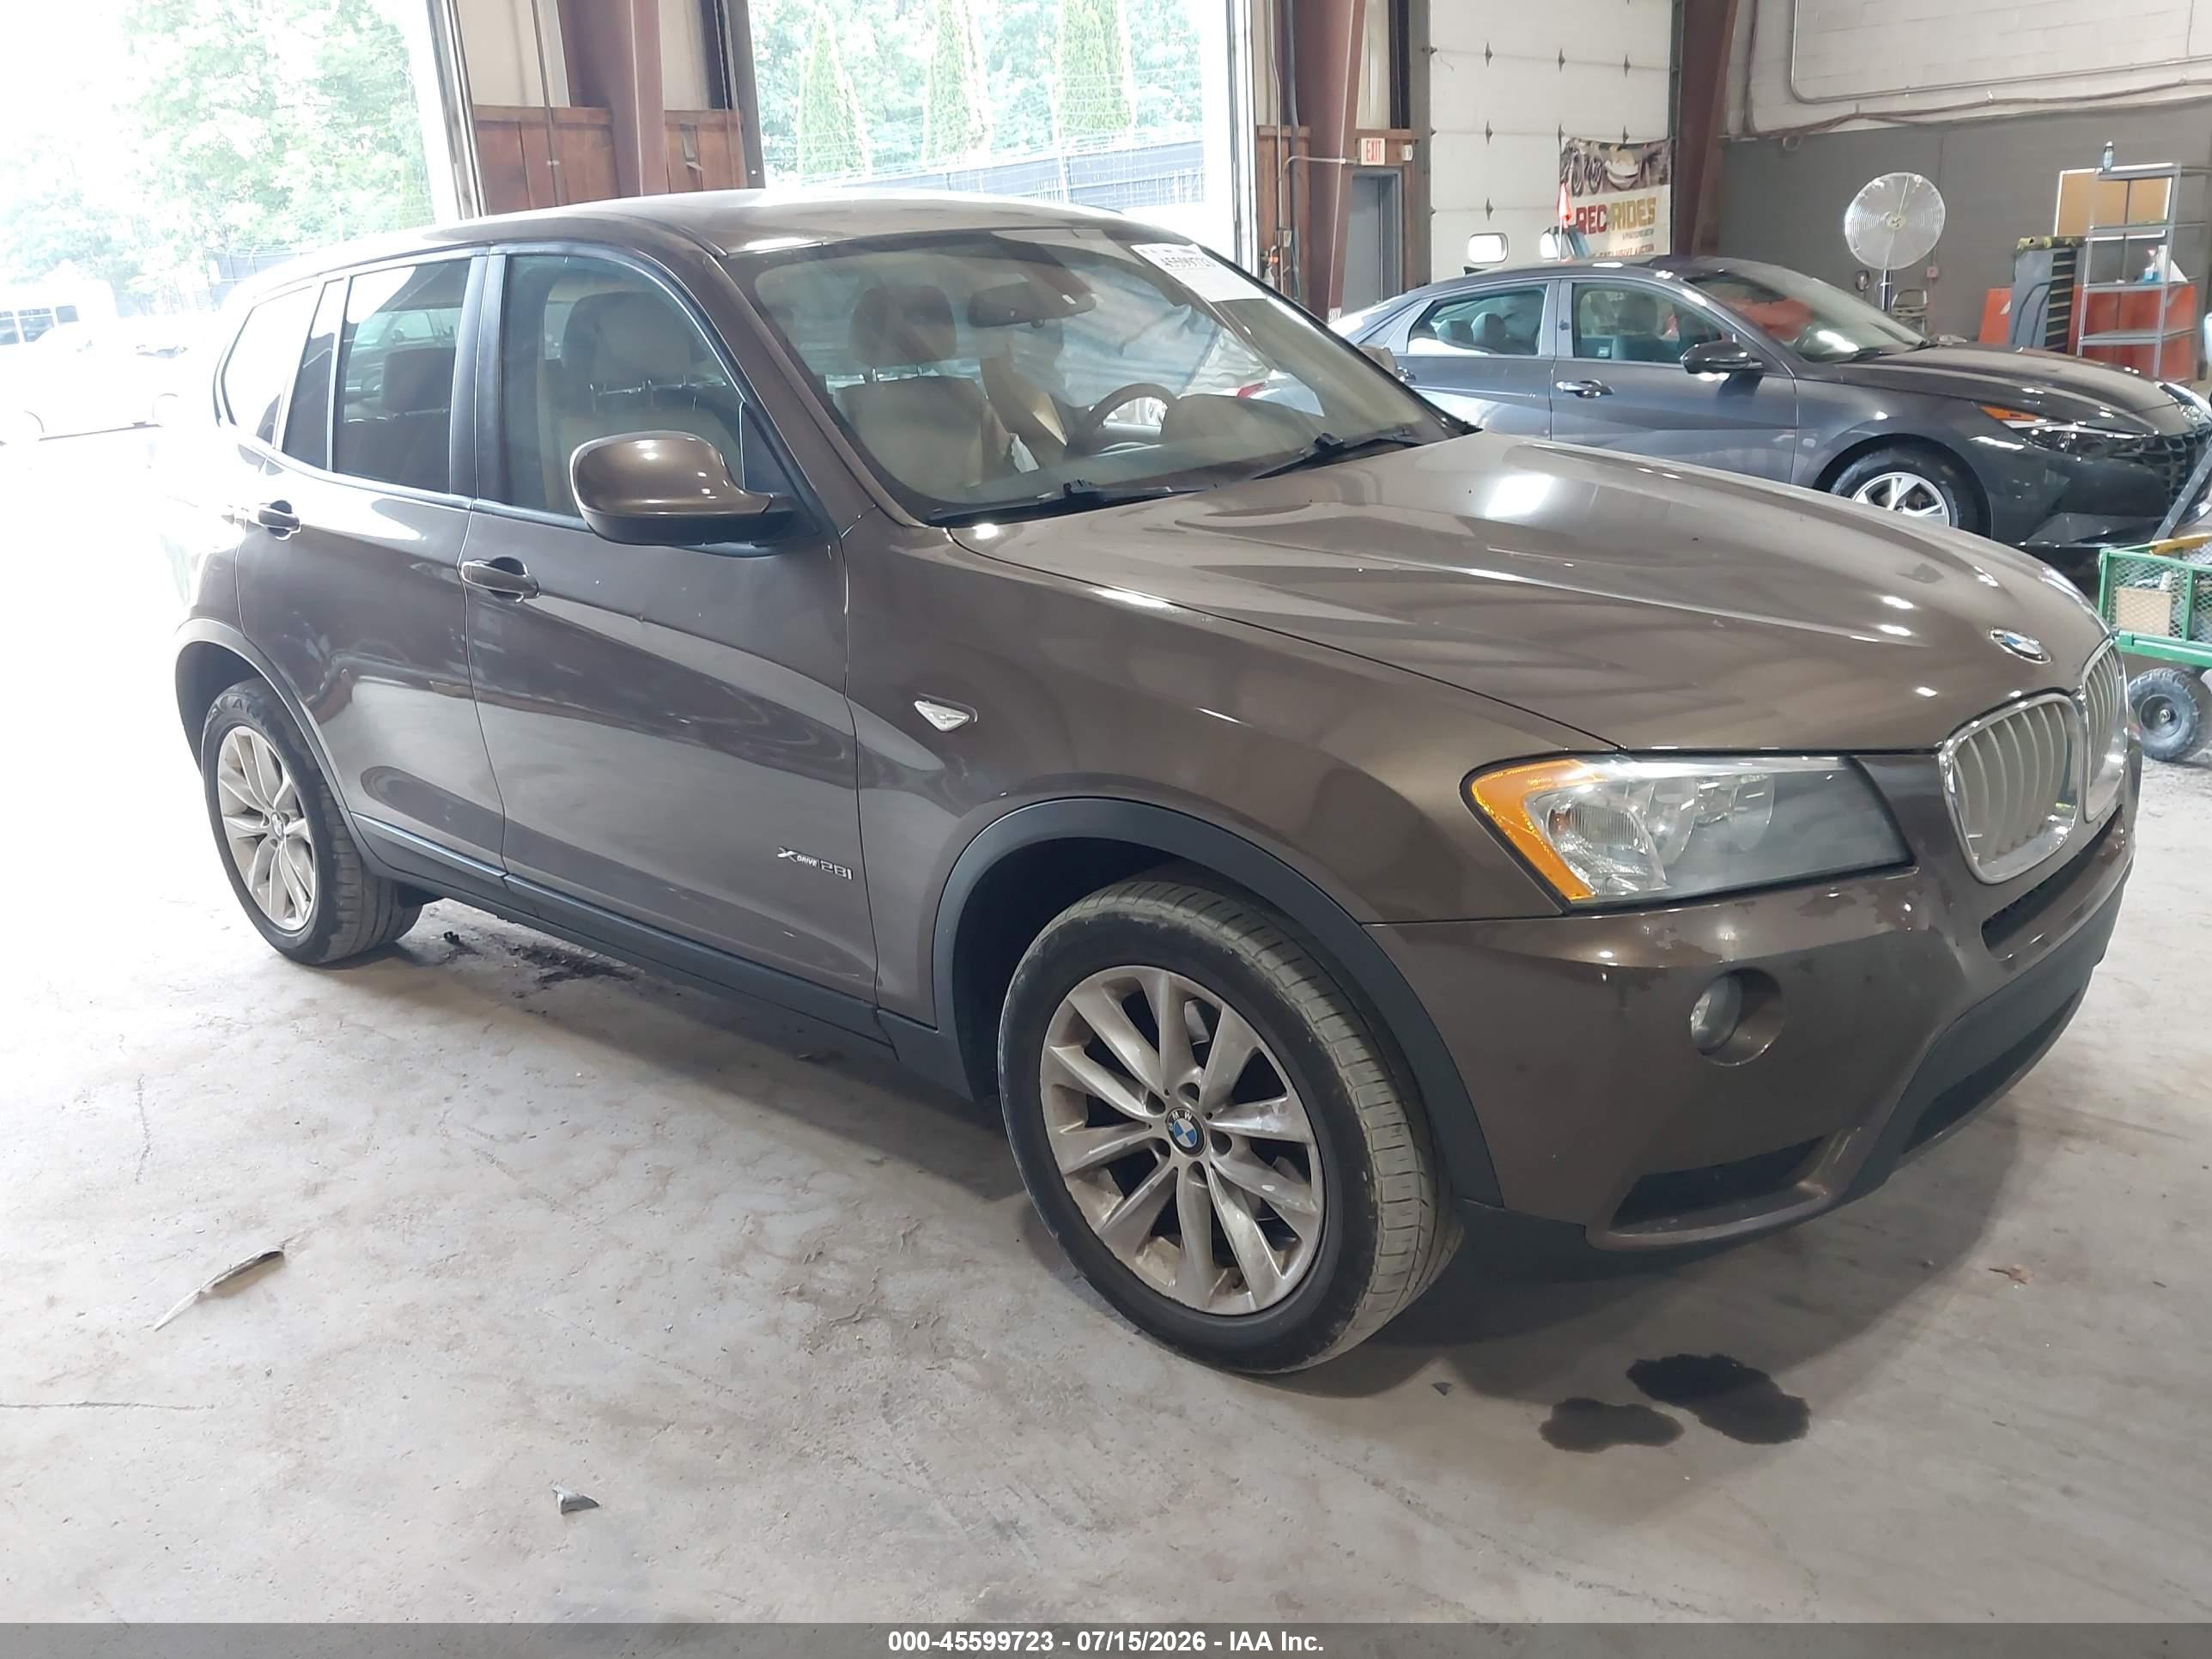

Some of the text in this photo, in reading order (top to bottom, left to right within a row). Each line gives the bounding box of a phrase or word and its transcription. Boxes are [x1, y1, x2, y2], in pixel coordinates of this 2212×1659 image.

[1576, 197, 1656, 235] REC RIDES
[1168, 1109, 1193, 1131] BMW
